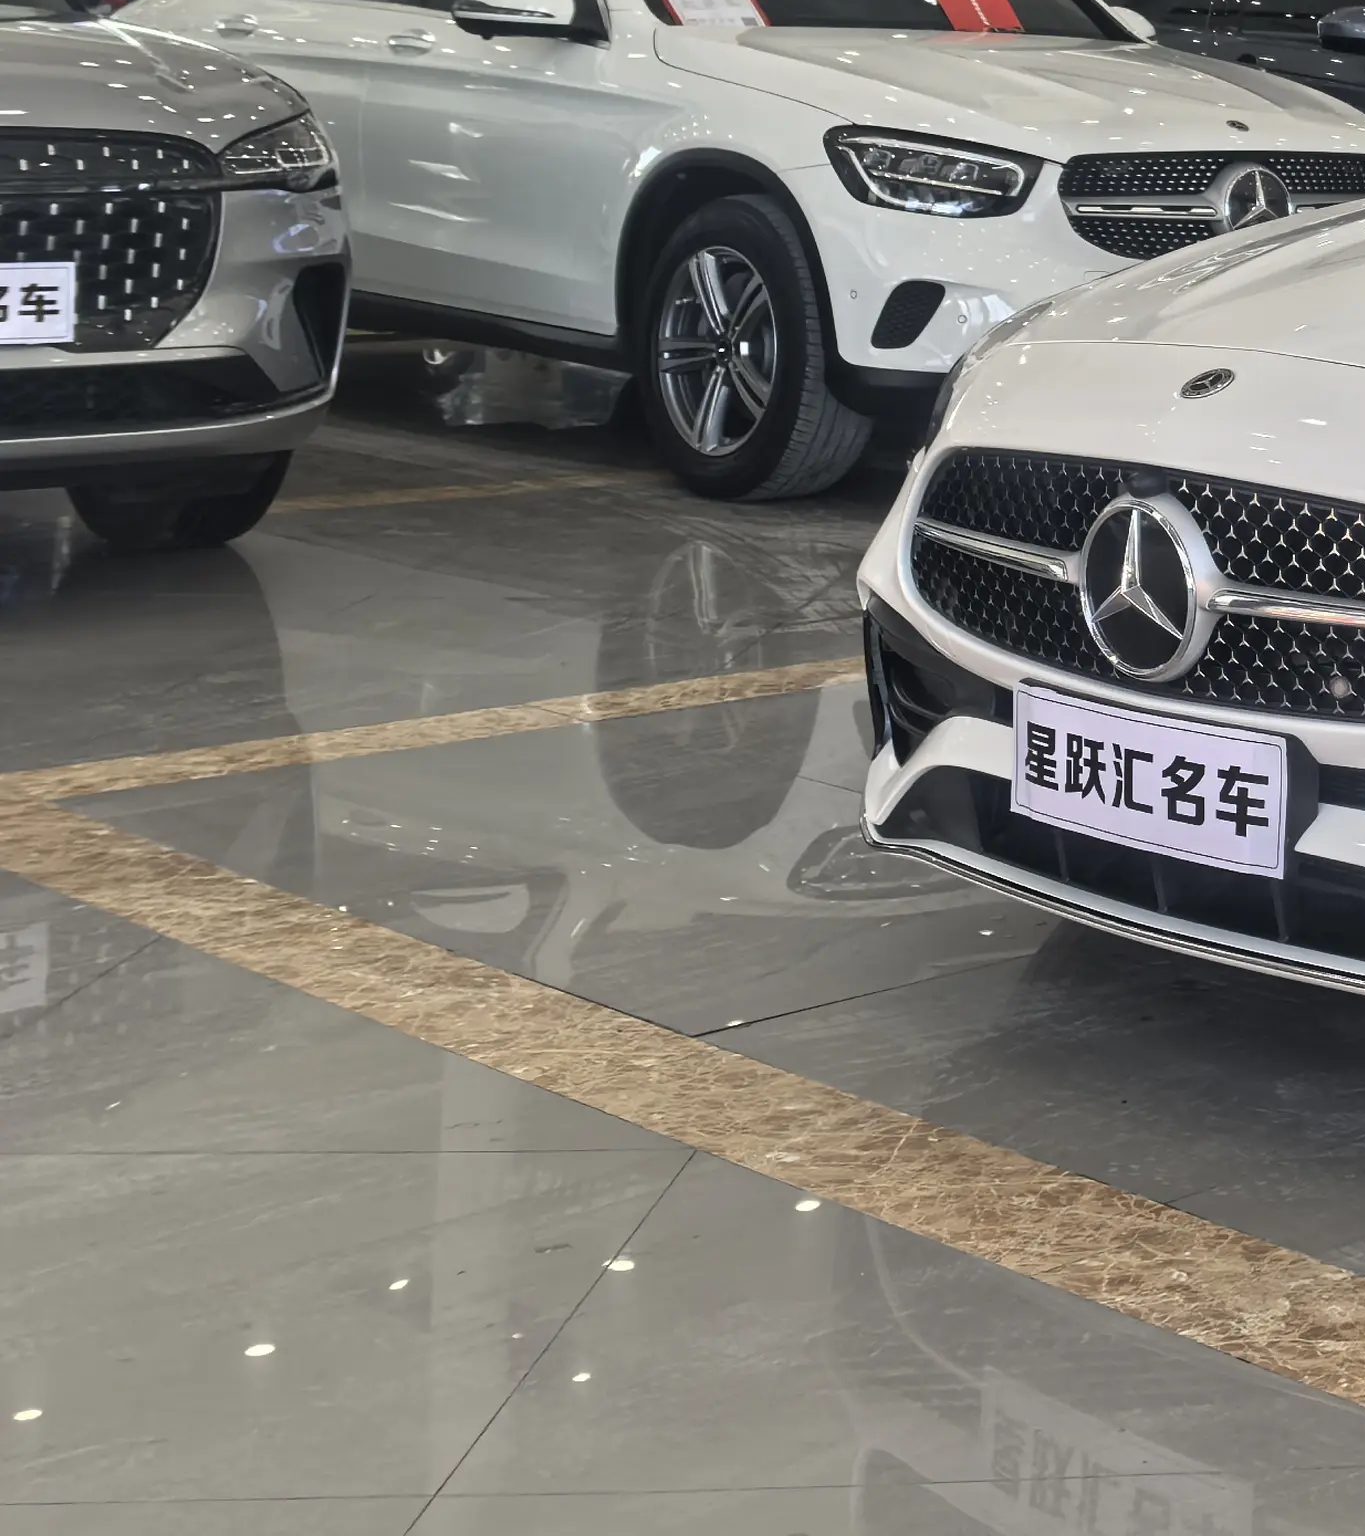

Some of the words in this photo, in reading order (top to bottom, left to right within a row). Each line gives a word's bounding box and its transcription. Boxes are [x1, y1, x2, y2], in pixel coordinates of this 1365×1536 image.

[0, 283, 61, 323] 车
[1024, 720, 1270, 838] 星跃汇名车
